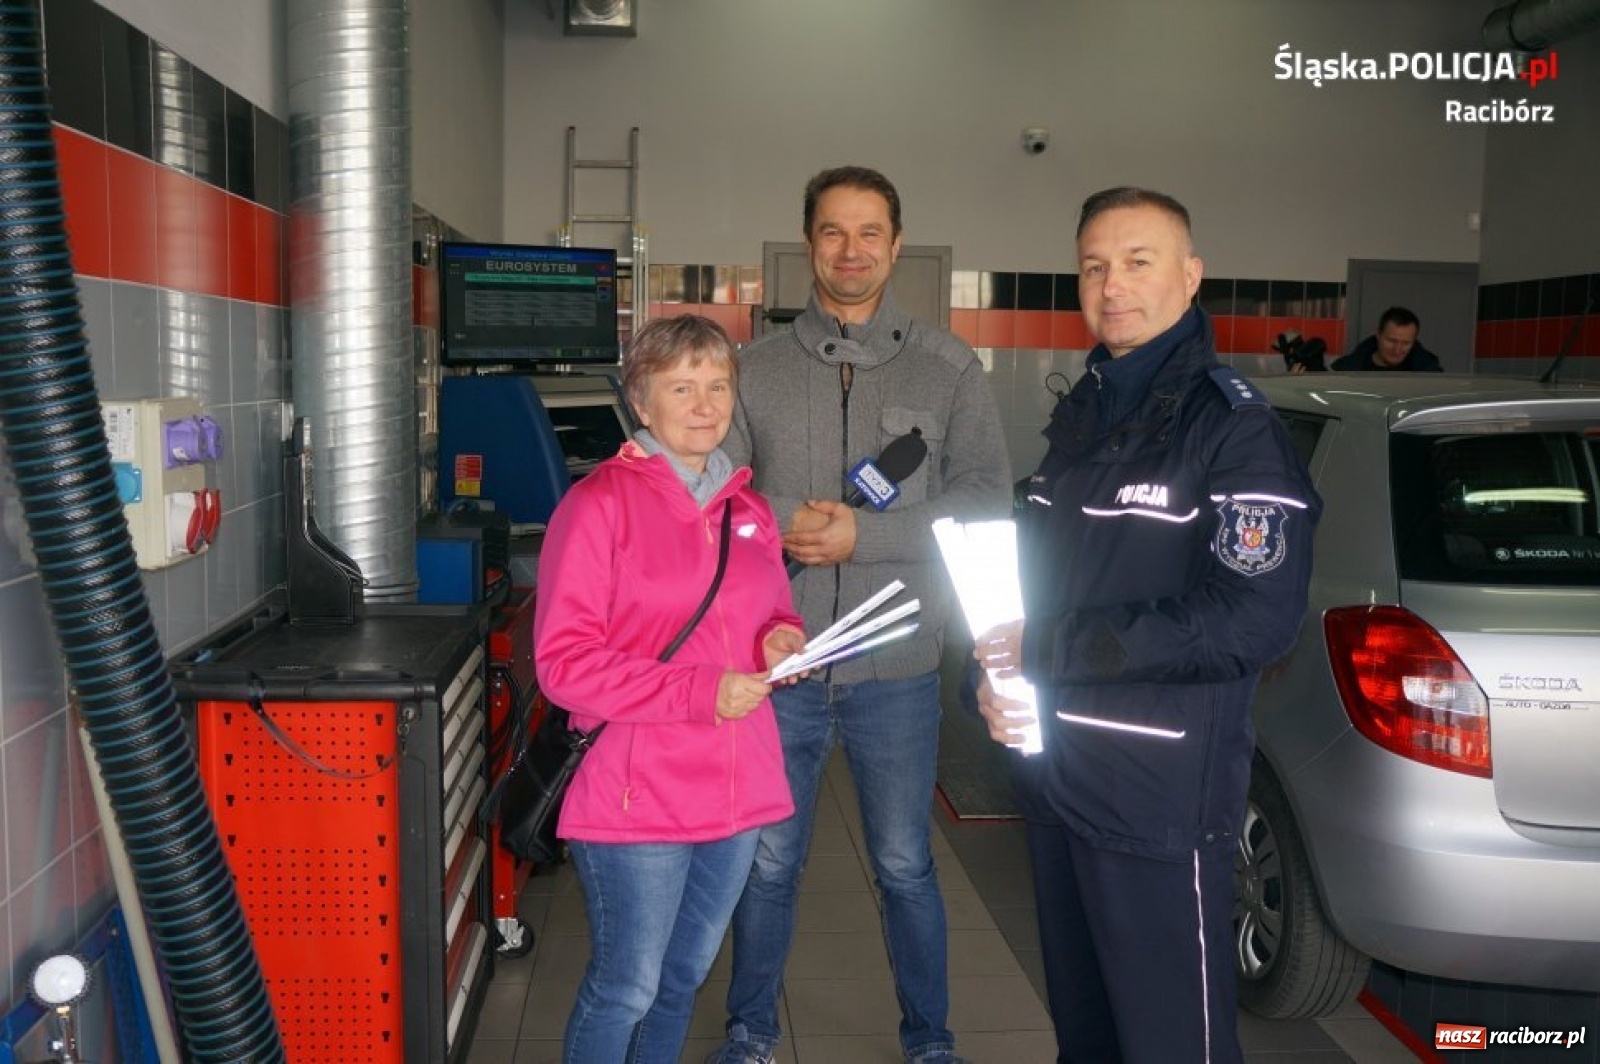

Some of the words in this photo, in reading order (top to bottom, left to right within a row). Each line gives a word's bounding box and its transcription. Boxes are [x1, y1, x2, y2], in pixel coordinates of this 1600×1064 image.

[486, 261, 577, 274] EUROSYSTEM
[1231, 504, 1276, 517] POLICJA
[1513, 548, 1569, 559] ŠKODA
[1498, 673, 1583, 692] ŠKODA
[1505, 700, 1532, 709] AUTO
